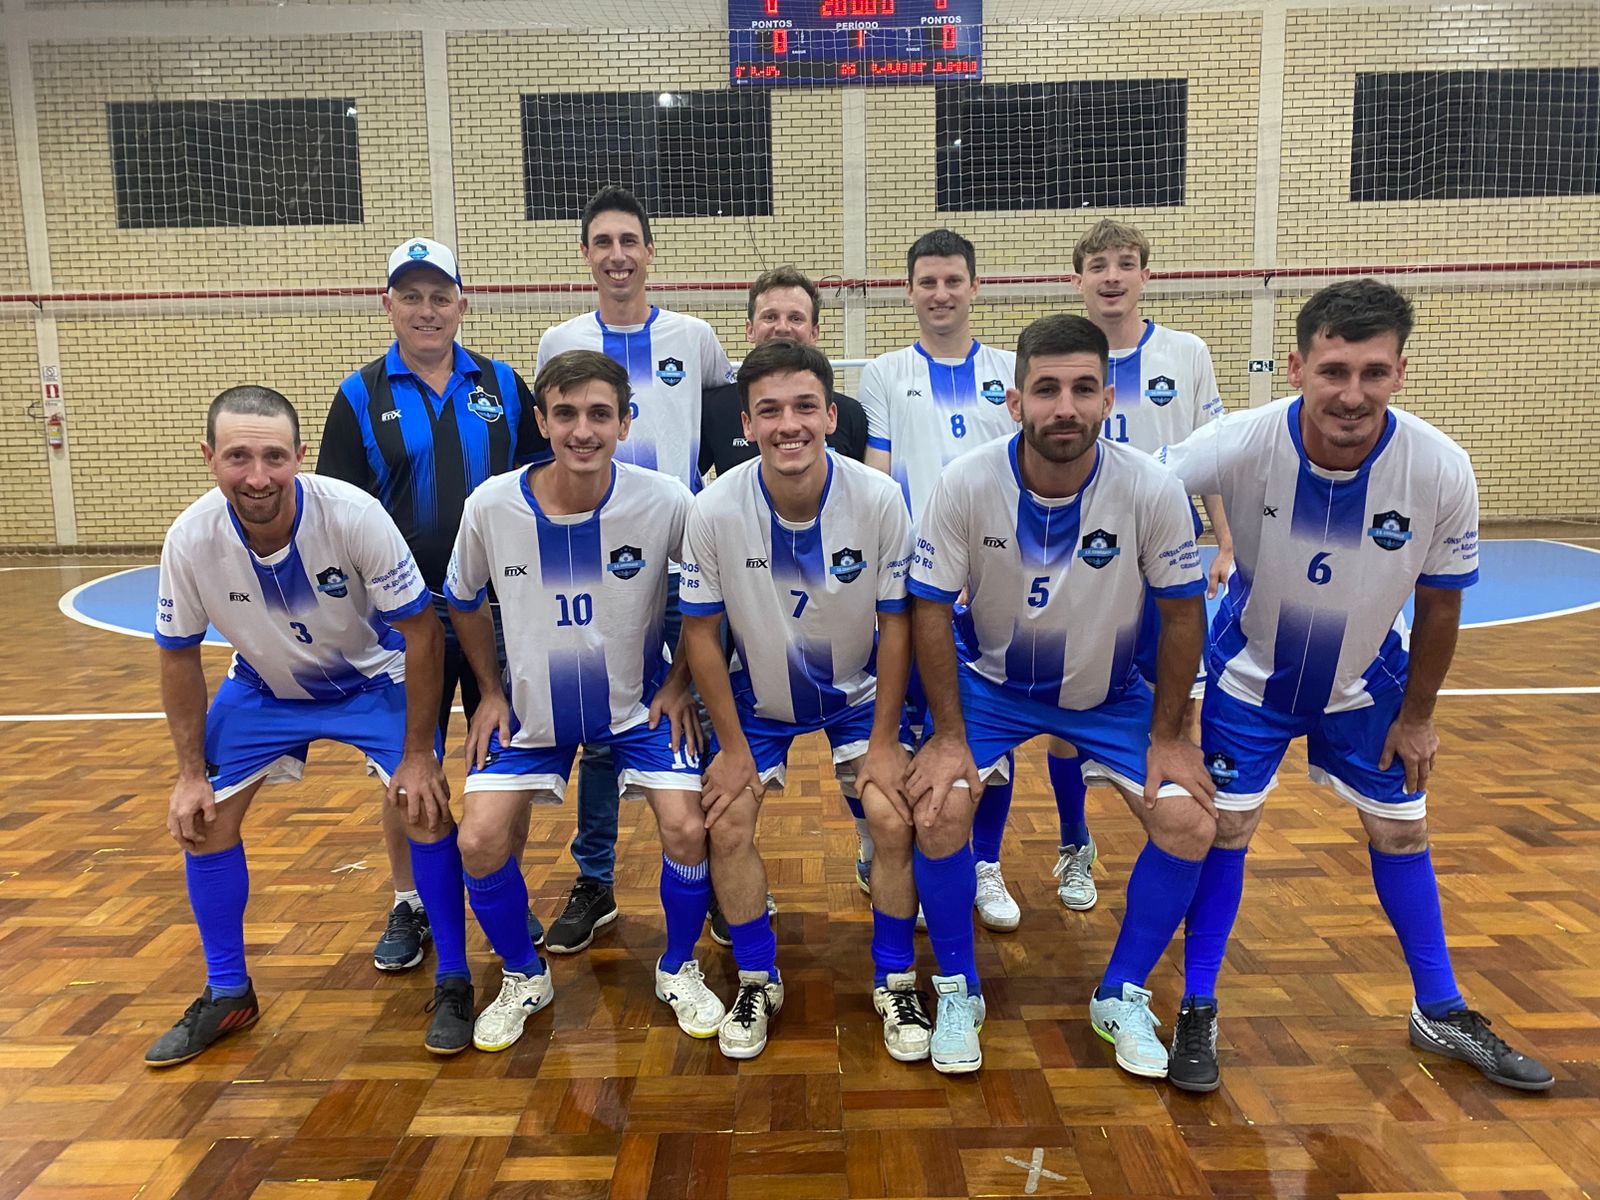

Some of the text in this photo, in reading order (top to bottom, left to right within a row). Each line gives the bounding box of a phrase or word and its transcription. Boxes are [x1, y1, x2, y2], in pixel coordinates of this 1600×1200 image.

[751, 20, 793, 29] PONTOS
[836, 21, 879, 30] PERÍODO
[920, 16, 962, 25] PONTOS
[942, 24, 956, 49] 0
[950, 414, 966, 439] 8
[922, 557, 934, 569] RS
[1307, 551, 1332, 585] 6
[687, 579, 700, 589] RS
[1027, 576, 1050, 609] 5
[159, 598, 174, 608] OS
[555, 593, 593, 627] 10
[790, 589, 809, 619] 7
[160, 612, 173, 623] RS
[289, 621, 313, 645] 3
